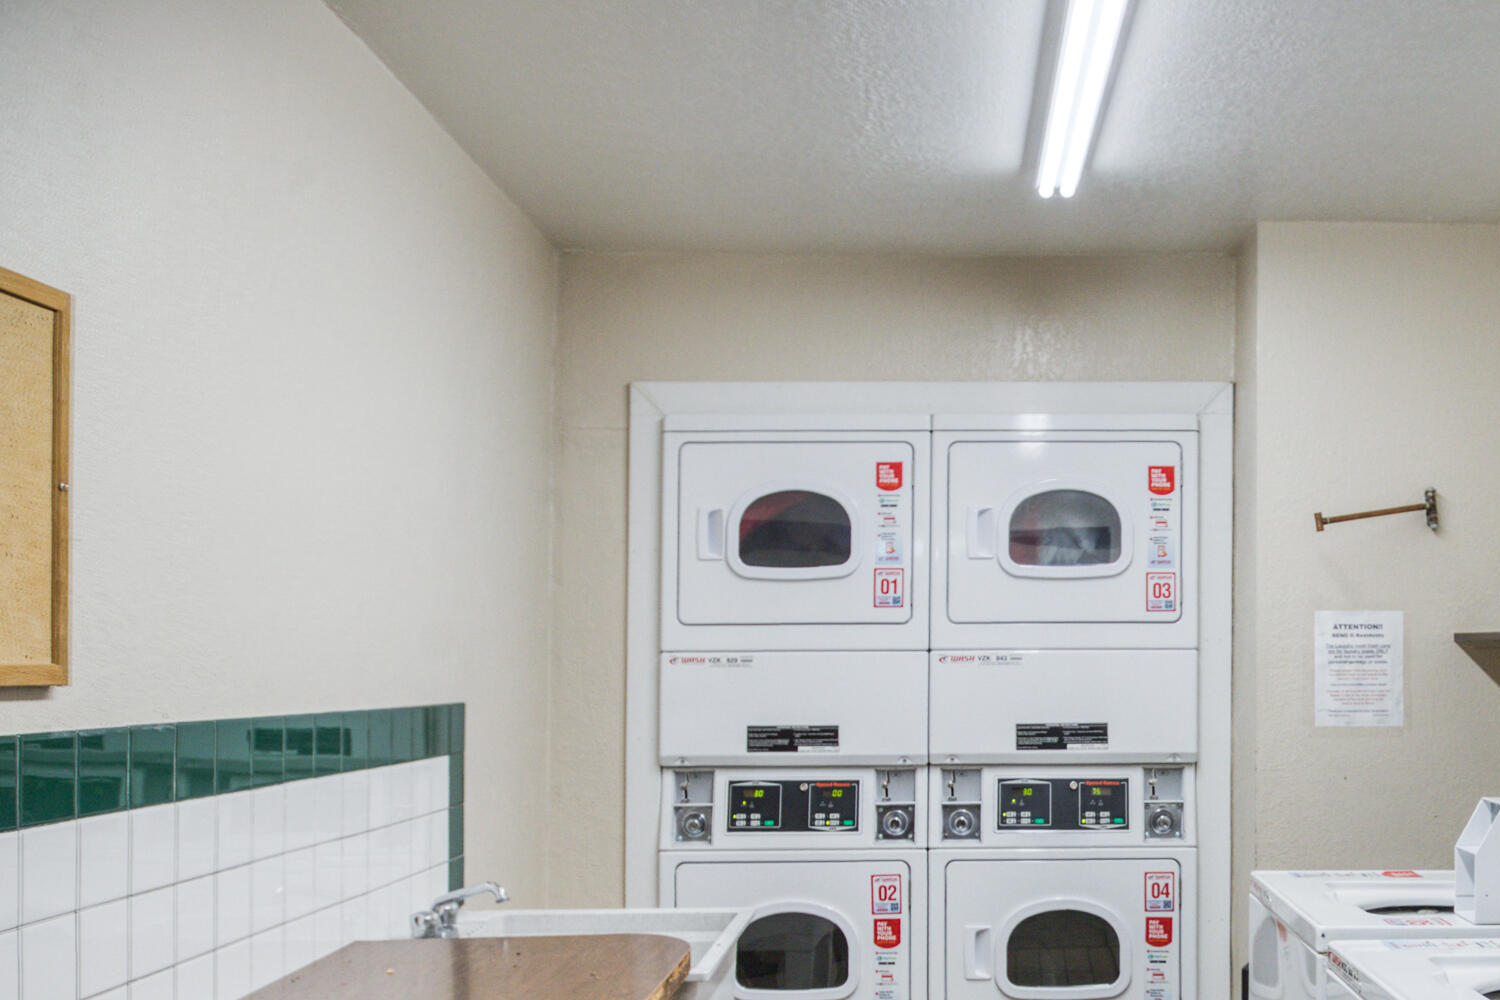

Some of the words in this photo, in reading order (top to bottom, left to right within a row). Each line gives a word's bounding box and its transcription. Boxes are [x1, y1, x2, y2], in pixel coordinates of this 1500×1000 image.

[880, 578, 897, 595] 01
[1152, 582, 1172, 599] 03
[878, 885, 897, 901] 02
[1152, 882, 1170, 899] 04
